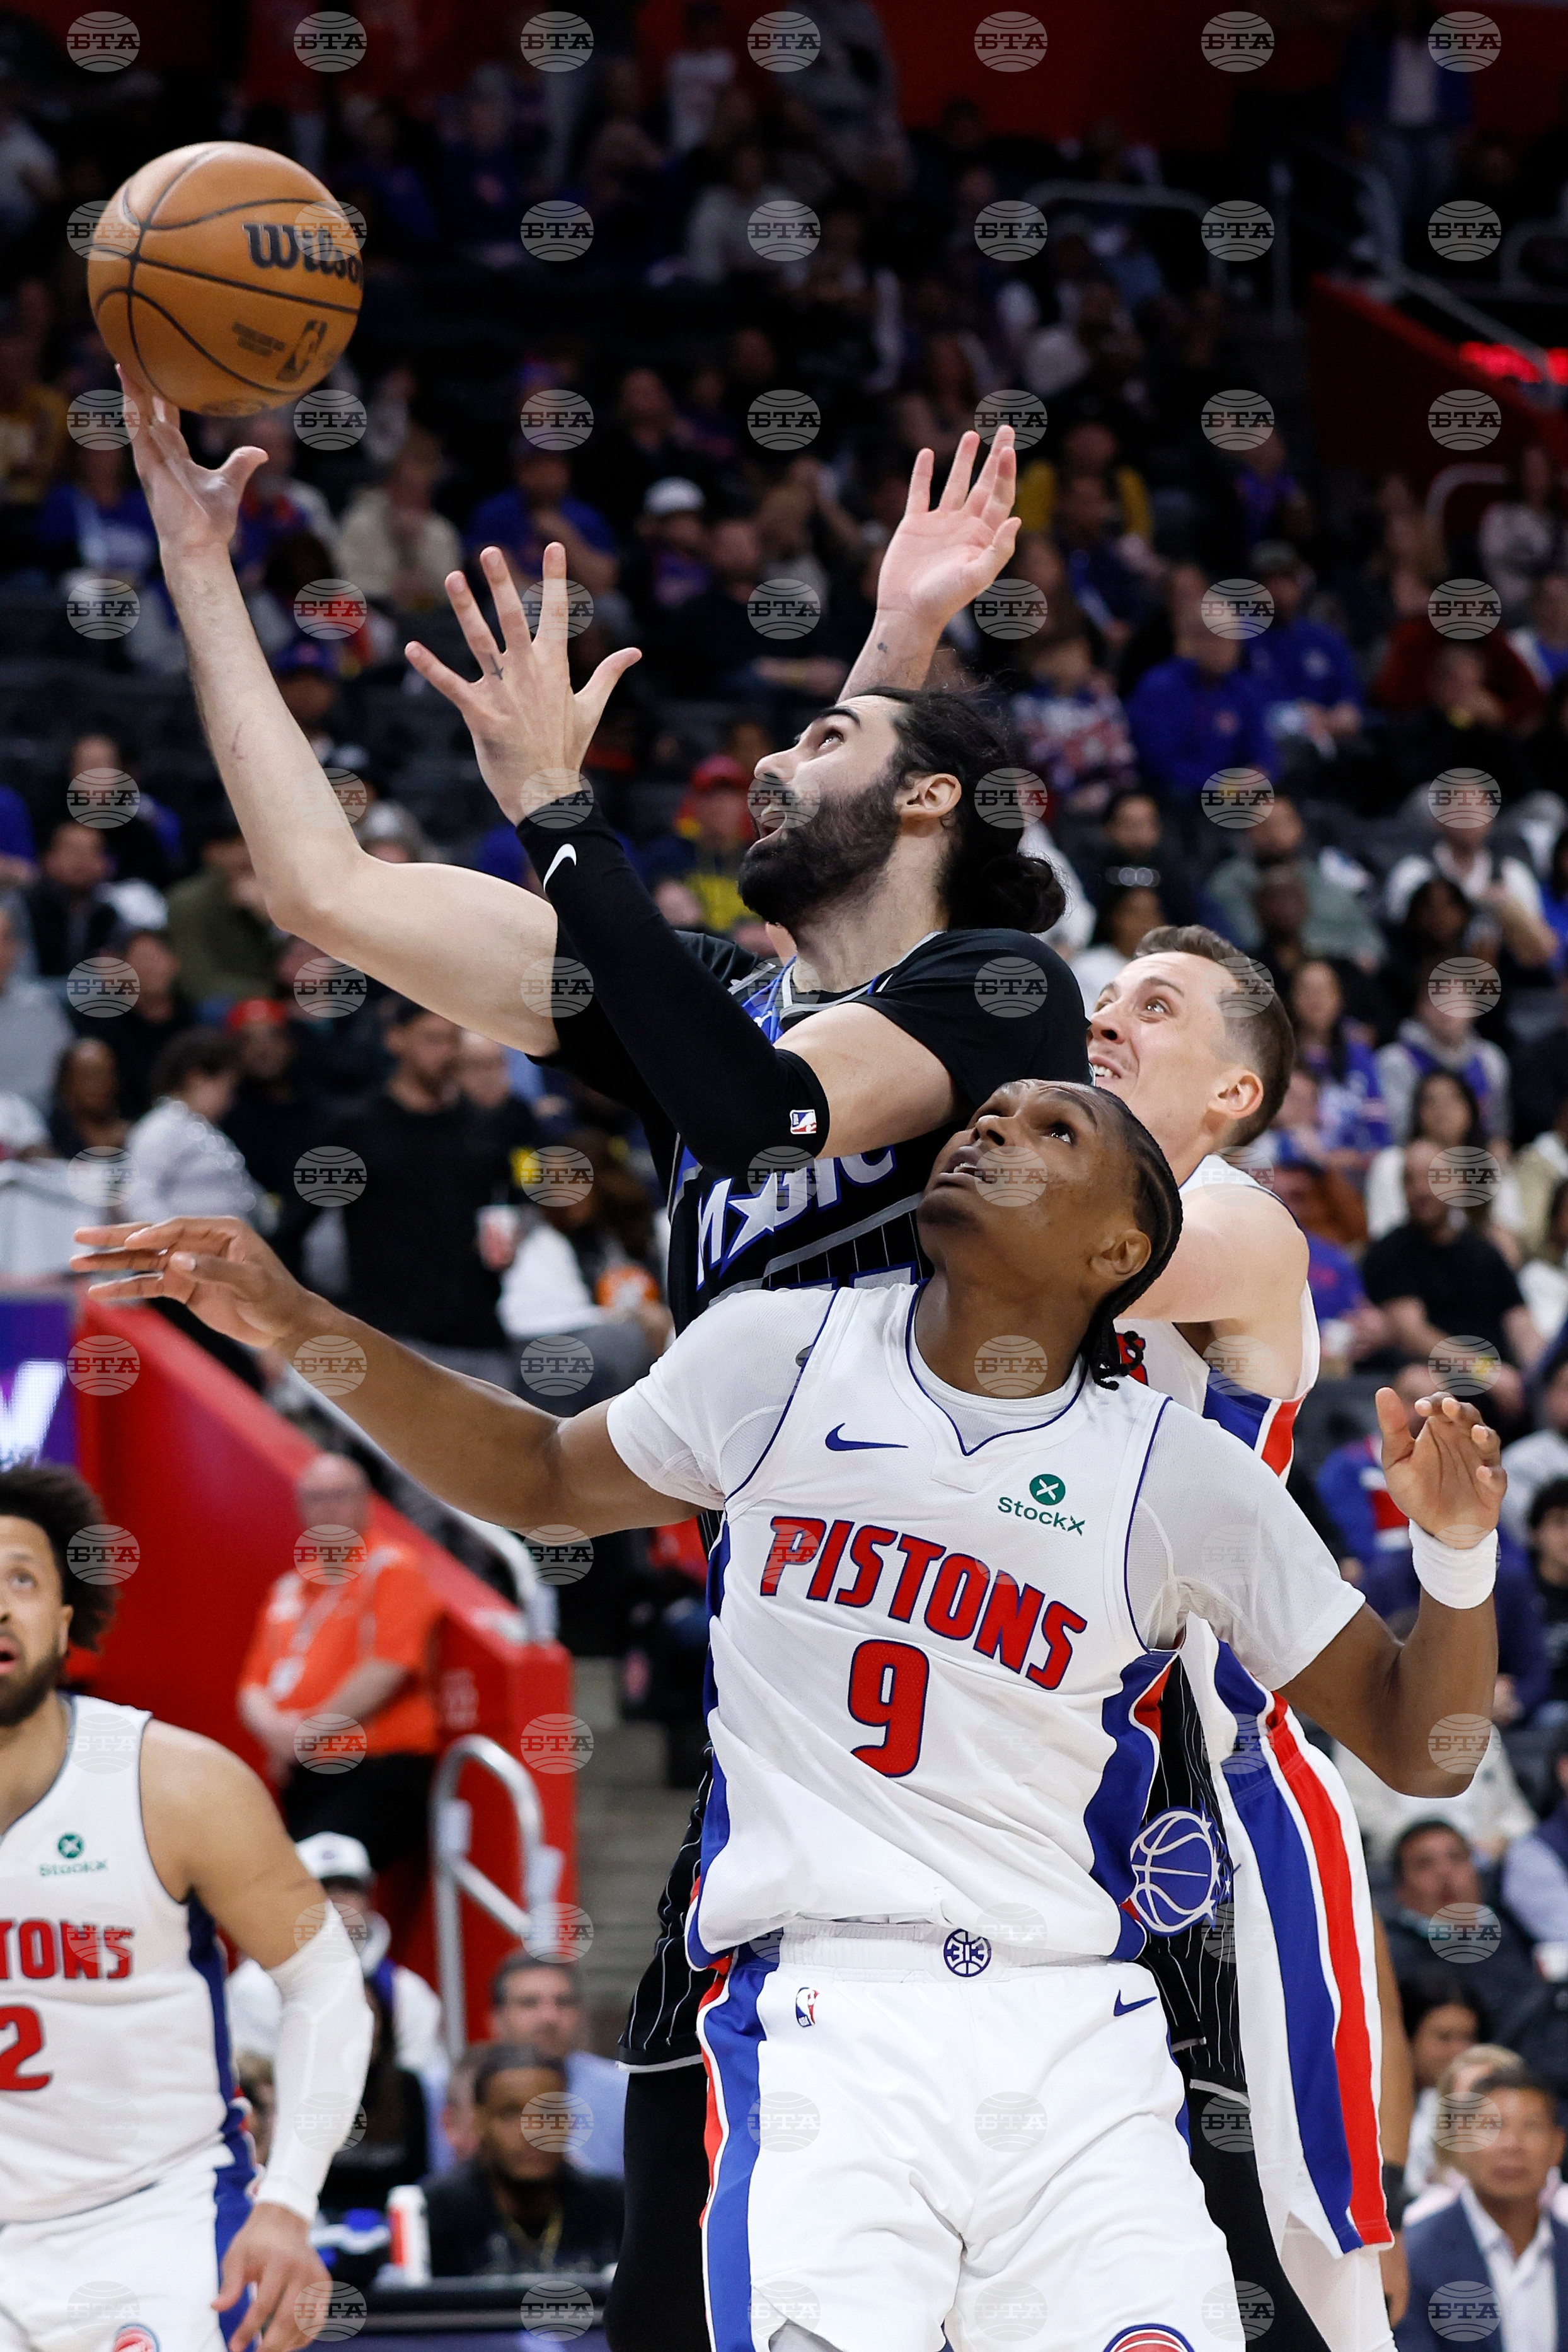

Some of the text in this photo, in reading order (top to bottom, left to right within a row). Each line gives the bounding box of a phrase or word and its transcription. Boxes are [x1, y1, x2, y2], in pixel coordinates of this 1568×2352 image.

[998, 1497, 1085, 1536] StockX
[759, 1515, 1088, 1690] PISTONS
[848, 1639, 930, 1777] 9
[0, 2005, 52, 2092] 2
